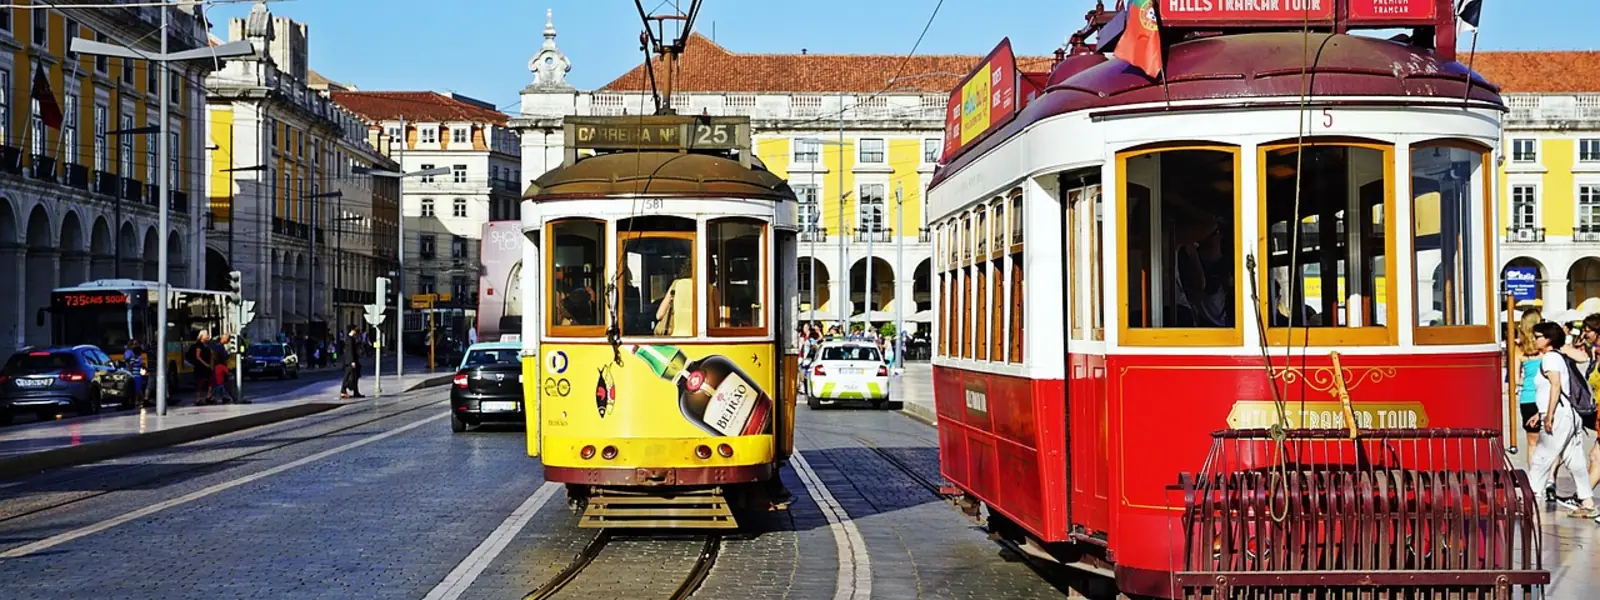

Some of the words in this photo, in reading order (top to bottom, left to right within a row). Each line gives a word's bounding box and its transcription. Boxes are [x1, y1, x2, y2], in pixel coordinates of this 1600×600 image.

[1169, 0, 1213, 12] HILLS
[1217, 0, 1280, 12] TRAMCAR
[1283, 0, 1321, 12] TOUR
[1374, 6, 1408, 14] TRAMCAR
[1323, 107, 1333, 128] 5
[697, 125, 729, 144] 25
[645, 198, 664, 210] 581
[64, 295, 86, 306] 735
[716, 384, 747, 430] BEIRÃO
[1298, 410, 1373, 429] TRAMAR
[1377, 410, 1417, 429] TOUR
